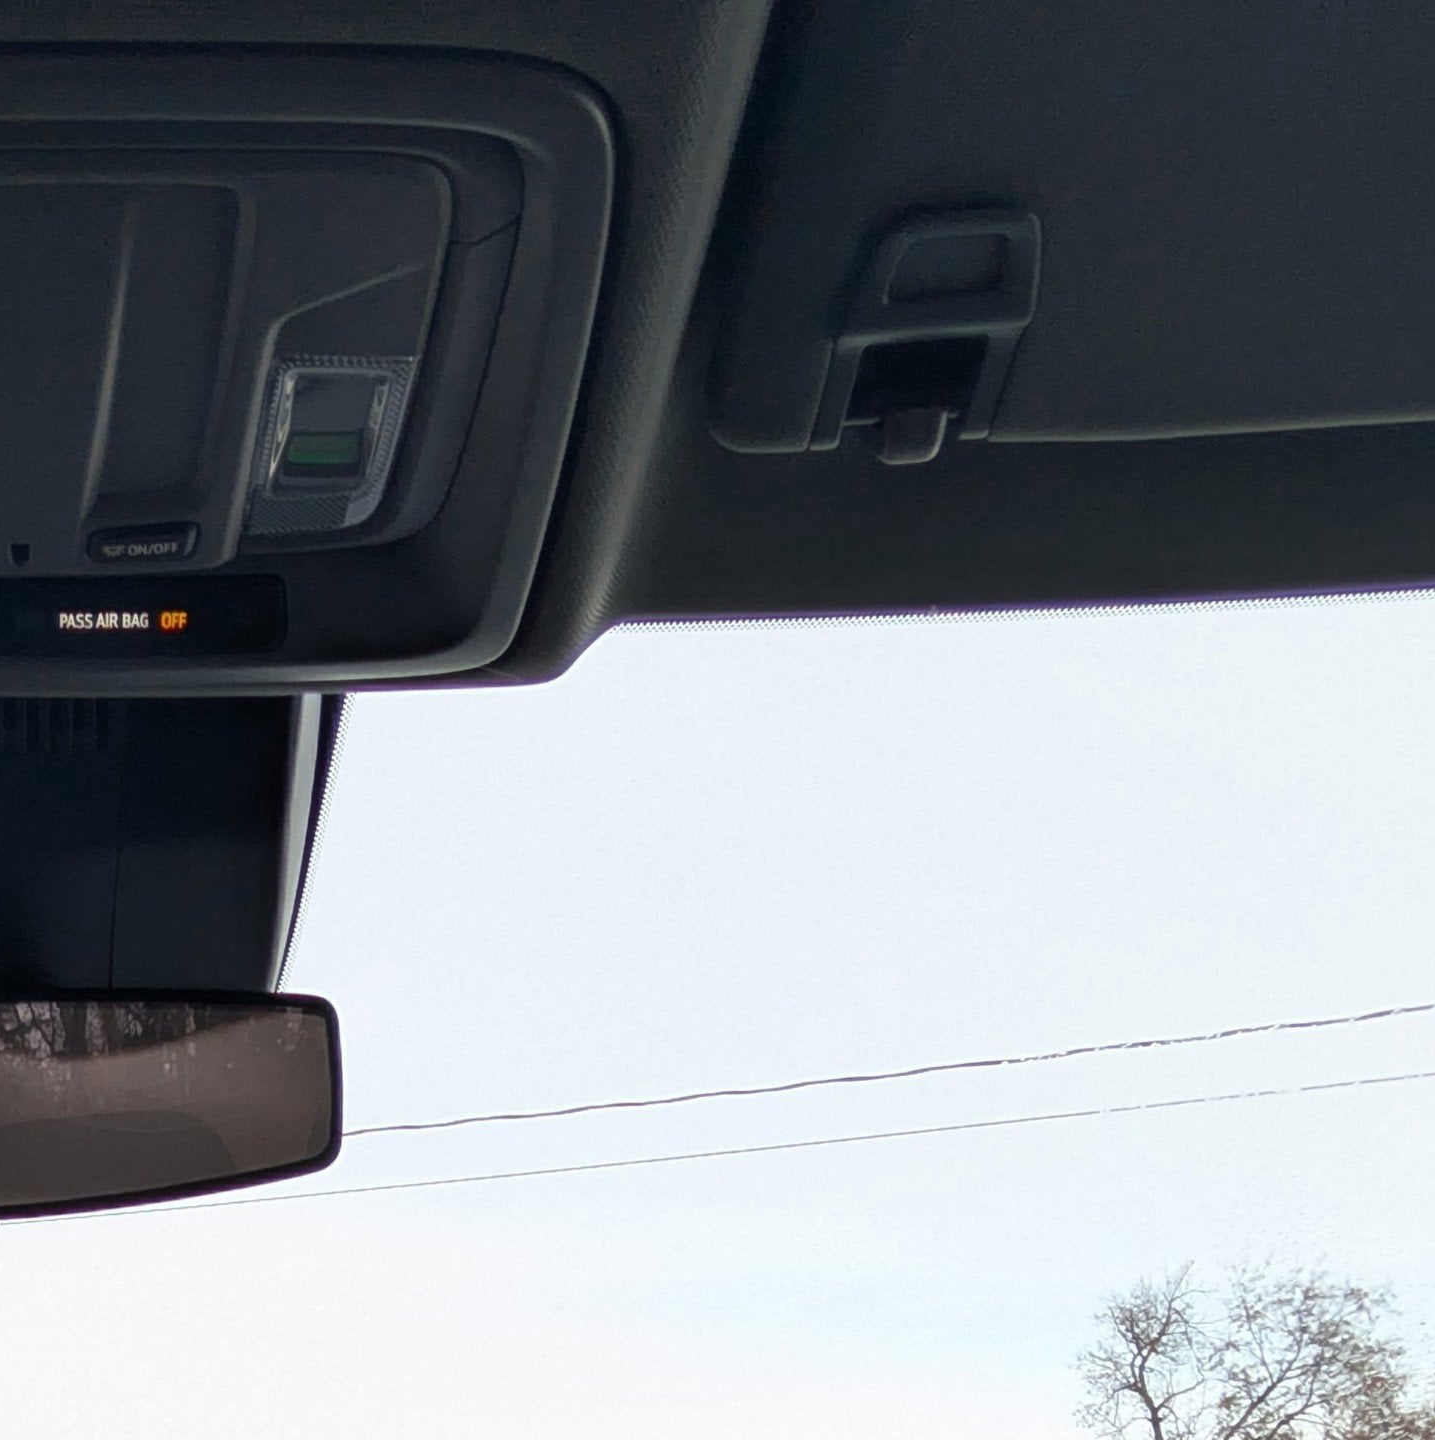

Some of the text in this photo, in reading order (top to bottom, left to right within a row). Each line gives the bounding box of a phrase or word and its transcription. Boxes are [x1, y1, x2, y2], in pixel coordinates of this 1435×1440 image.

[126, 540, 180, 557] ON/OFF
[58, 610, 189, 631] PASS AIR BAG OFF
